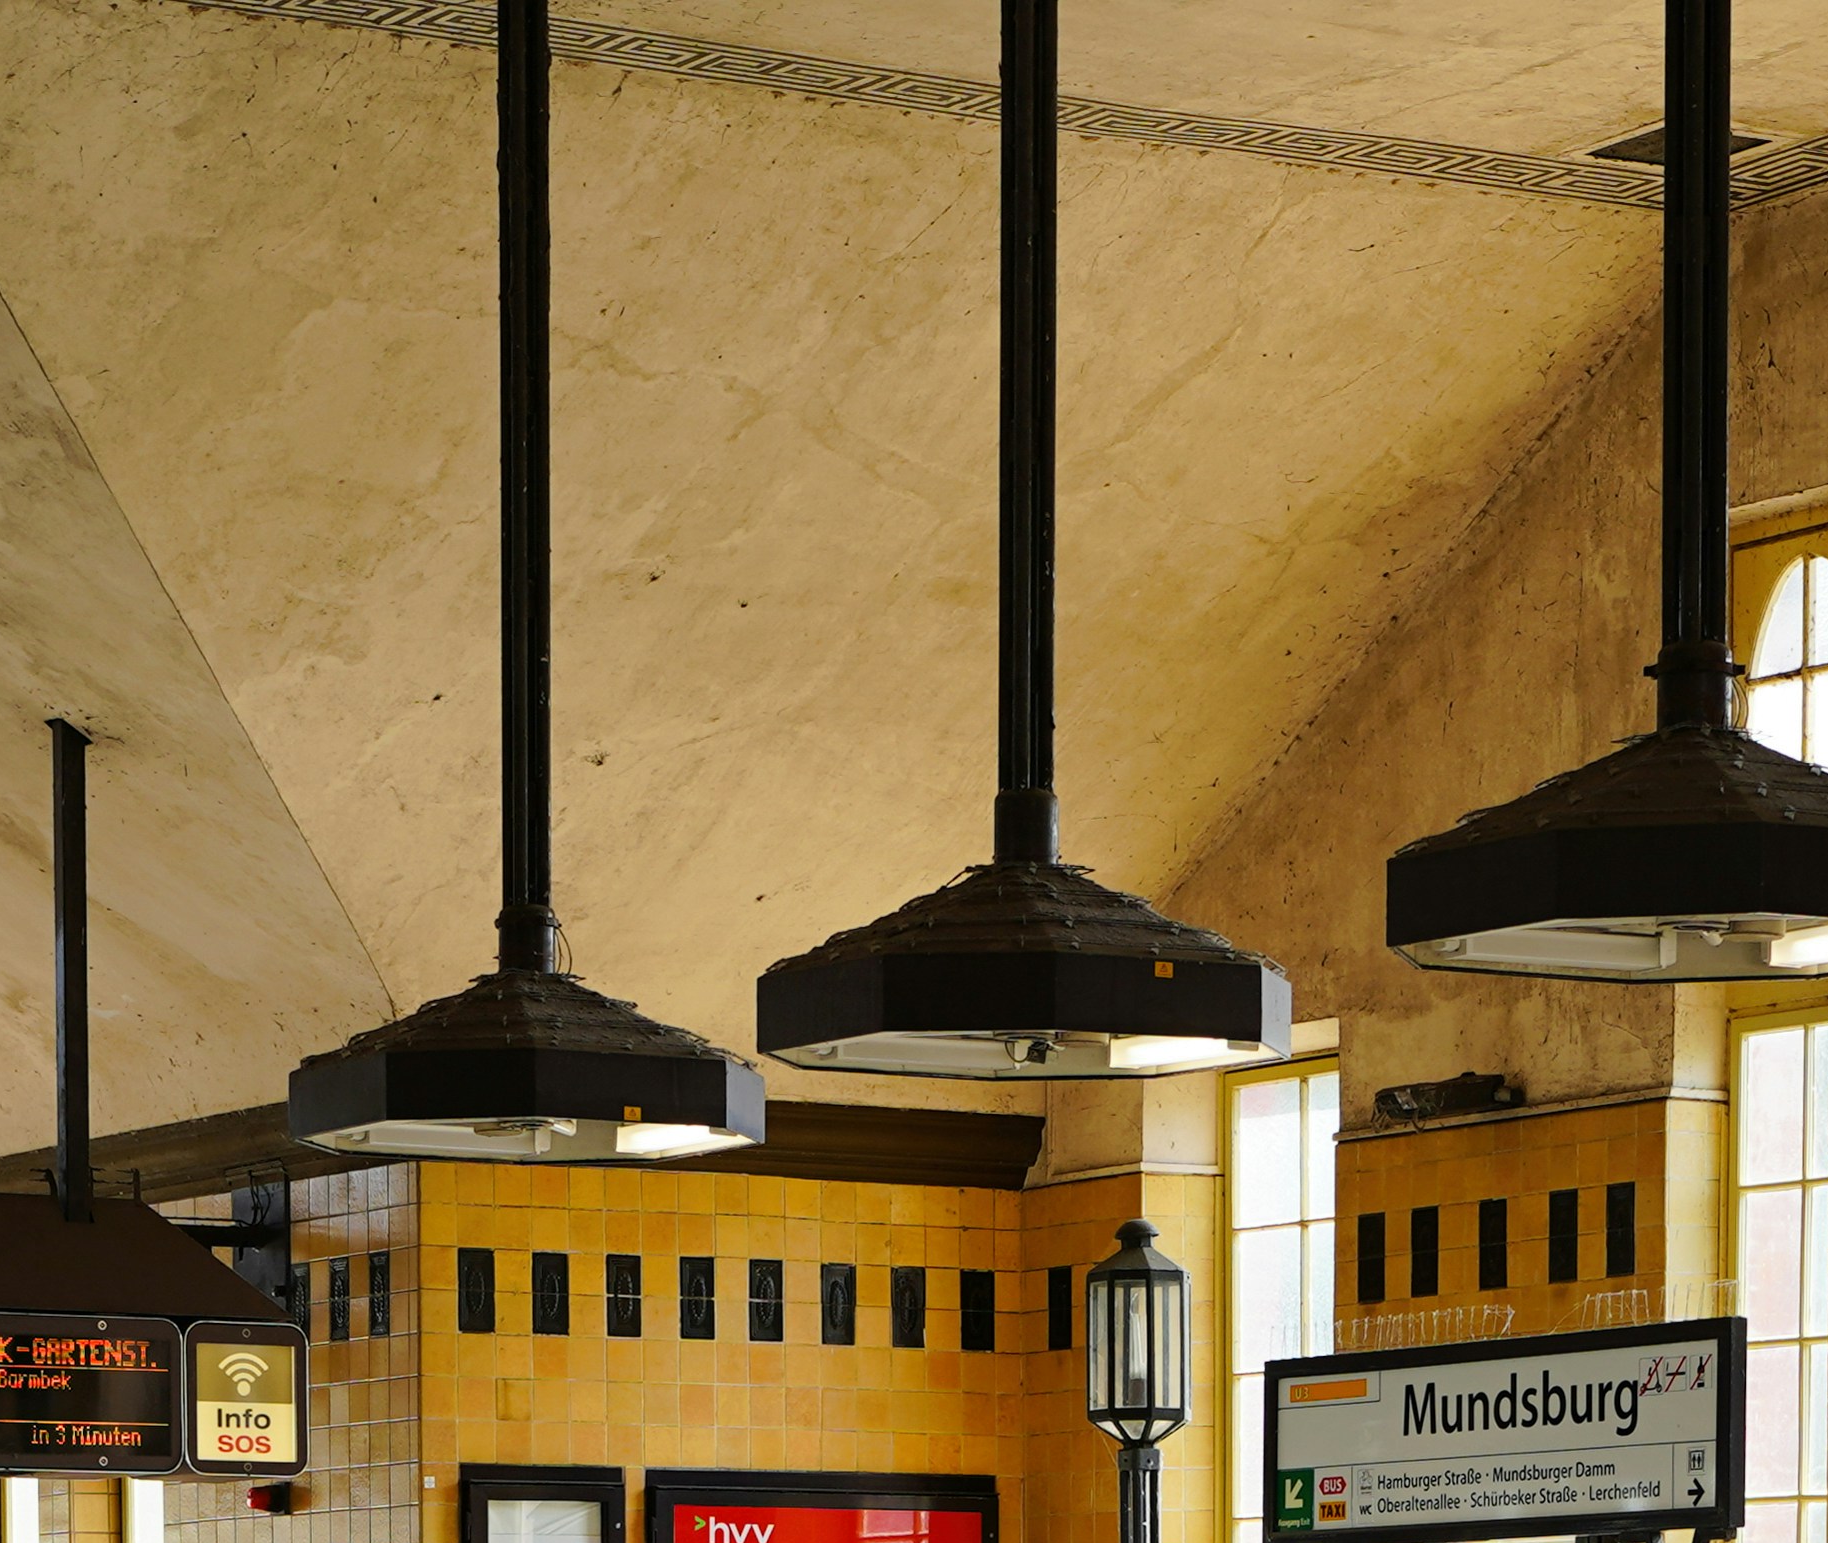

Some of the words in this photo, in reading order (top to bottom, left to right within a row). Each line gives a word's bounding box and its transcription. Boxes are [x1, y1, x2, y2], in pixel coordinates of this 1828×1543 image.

[1294, 1387, 1310, 1399] U3
[1403, 1370, 1639, 1437] Mundsburg
[216, 1408, 271, 1430] Info
[31, 1426, 50, 1444] in
[56, 1427, 66, 1445] 3
[72, 1427, 142, 1447] Minuten
[217, 1434, 272, 1454] SOS
[1323, 1478, 1343, 1493] BUS
[1377, 1472, 1442, 1492] Hamburger
[1444, 1467, 1482, 1486] Straße
[1492, 1464, 1573, 1483] Mundsburger
[1575, 1461, 1615, 1478] Damm
[1377, 1494, 1461, 1513] Oberaltenallee
[1470, 1489, 1537, 1508] Schürbeker
[1539, 1486, 1578, 1504] Straße
[1588, 1481, 1661, 1501] Lerchenfeld
[1321, 1502, 1346, 1519] TAXI
